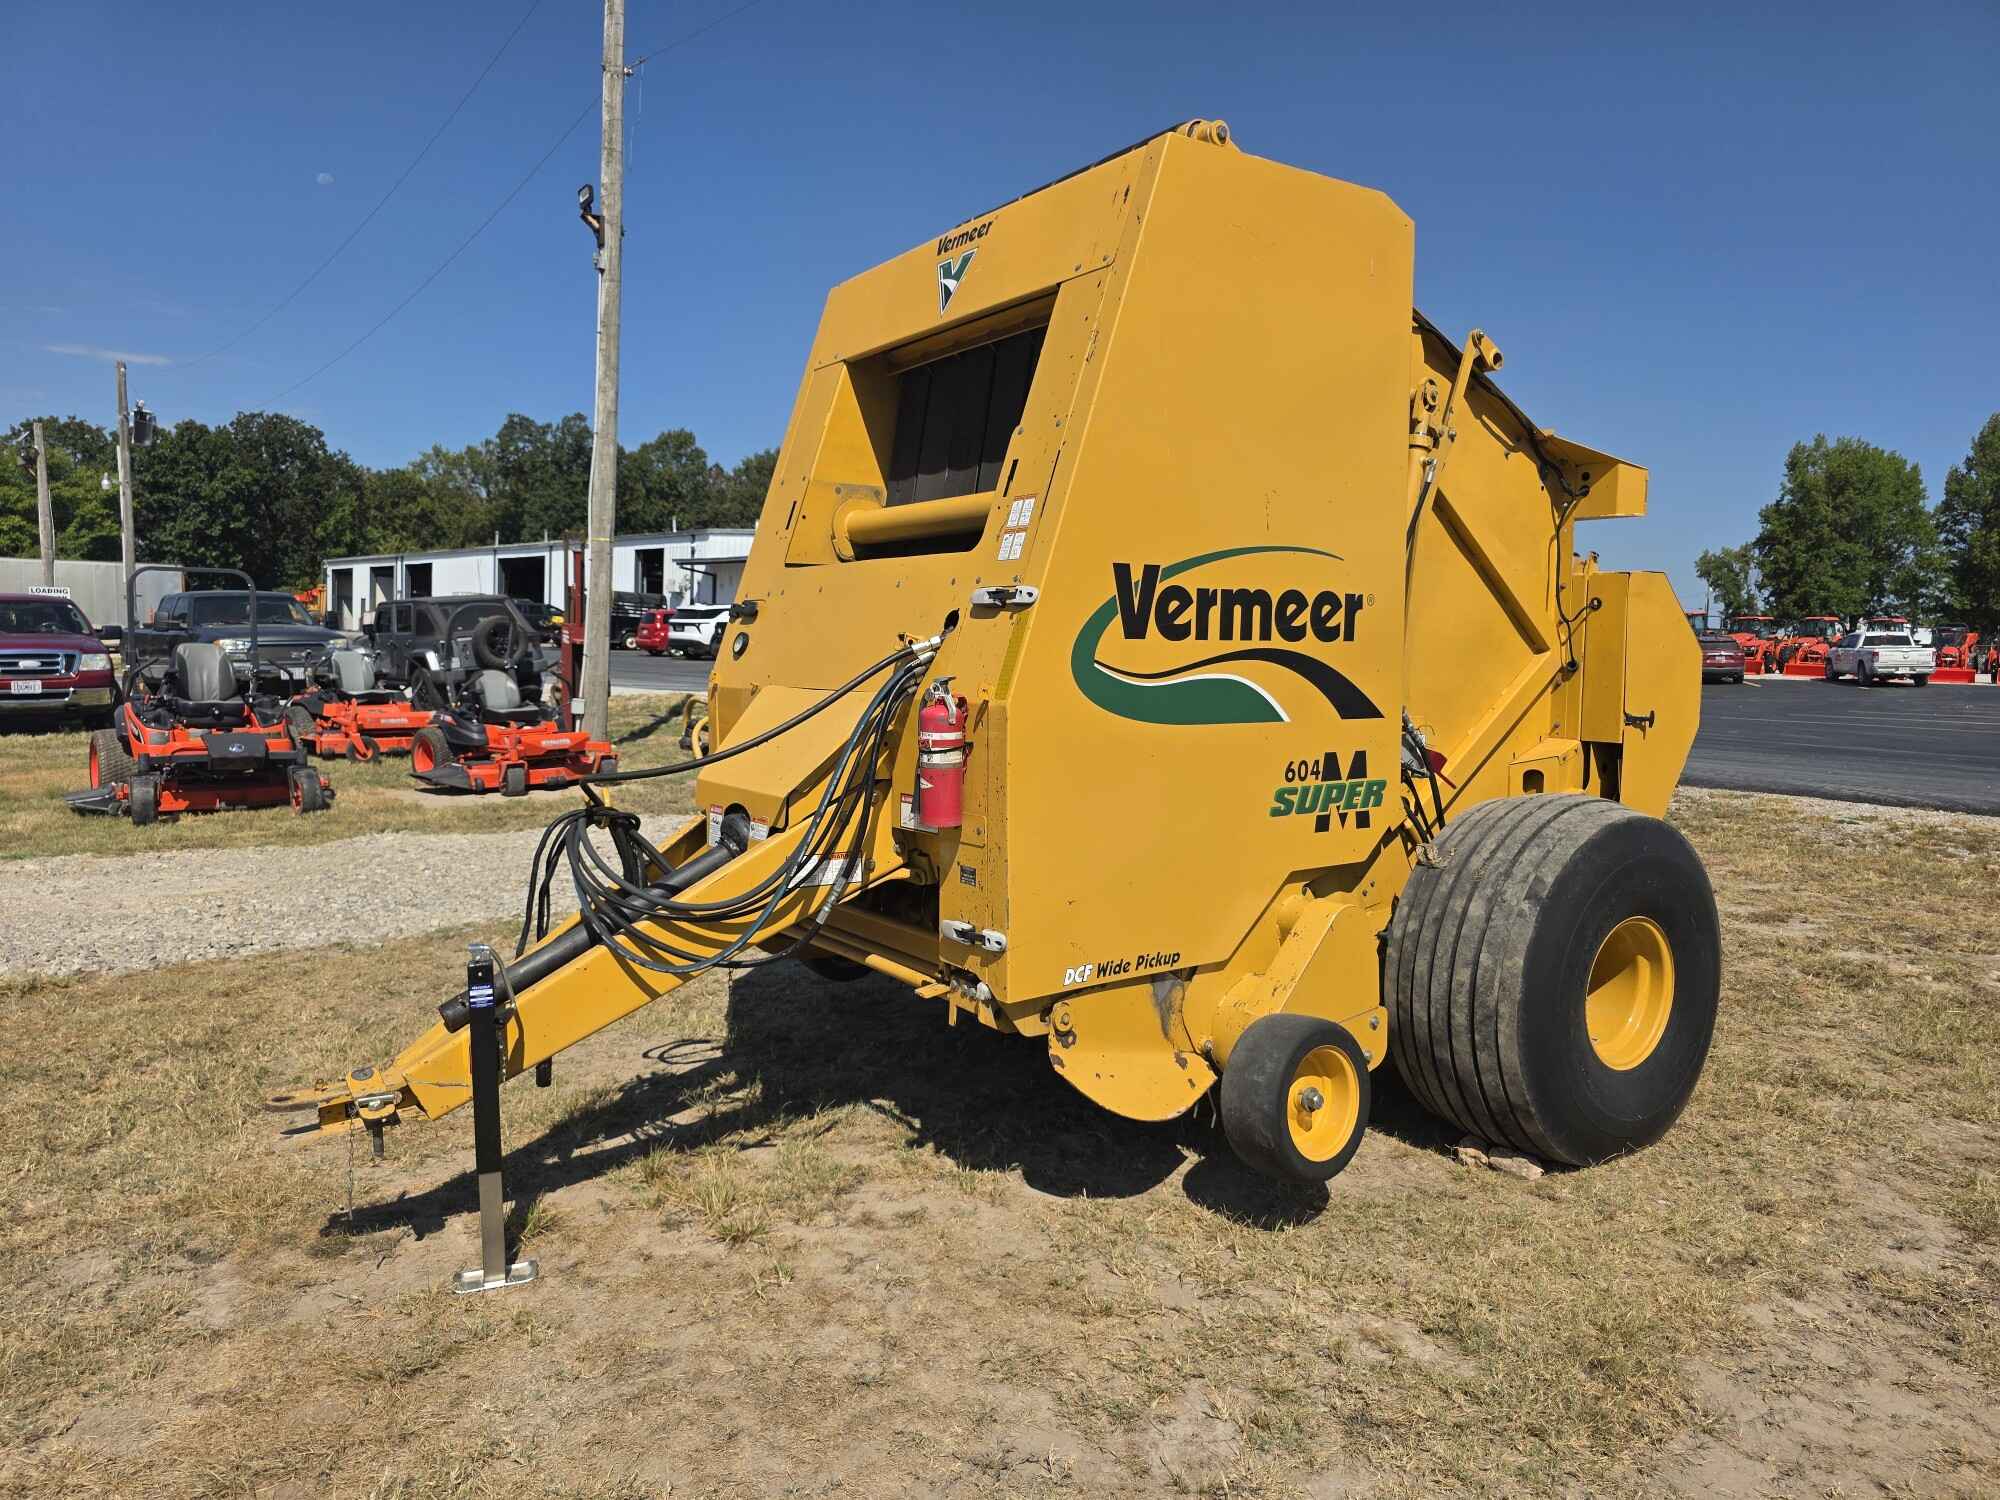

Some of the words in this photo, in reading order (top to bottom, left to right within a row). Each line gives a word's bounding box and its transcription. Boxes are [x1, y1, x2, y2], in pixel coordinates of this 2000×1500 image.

[936, 221, 993, 256] Vermeer
[1112, 562, 1363, 642] Vermeer
[1284, 759, 1321, 783] 604
[1269, 779, 1387, 817] SUPER
[1062, 963, 1093, 986] DCF
[1096, 958, 1131, 979] Wide
[1135, 951, 1181, 971] Pickup
